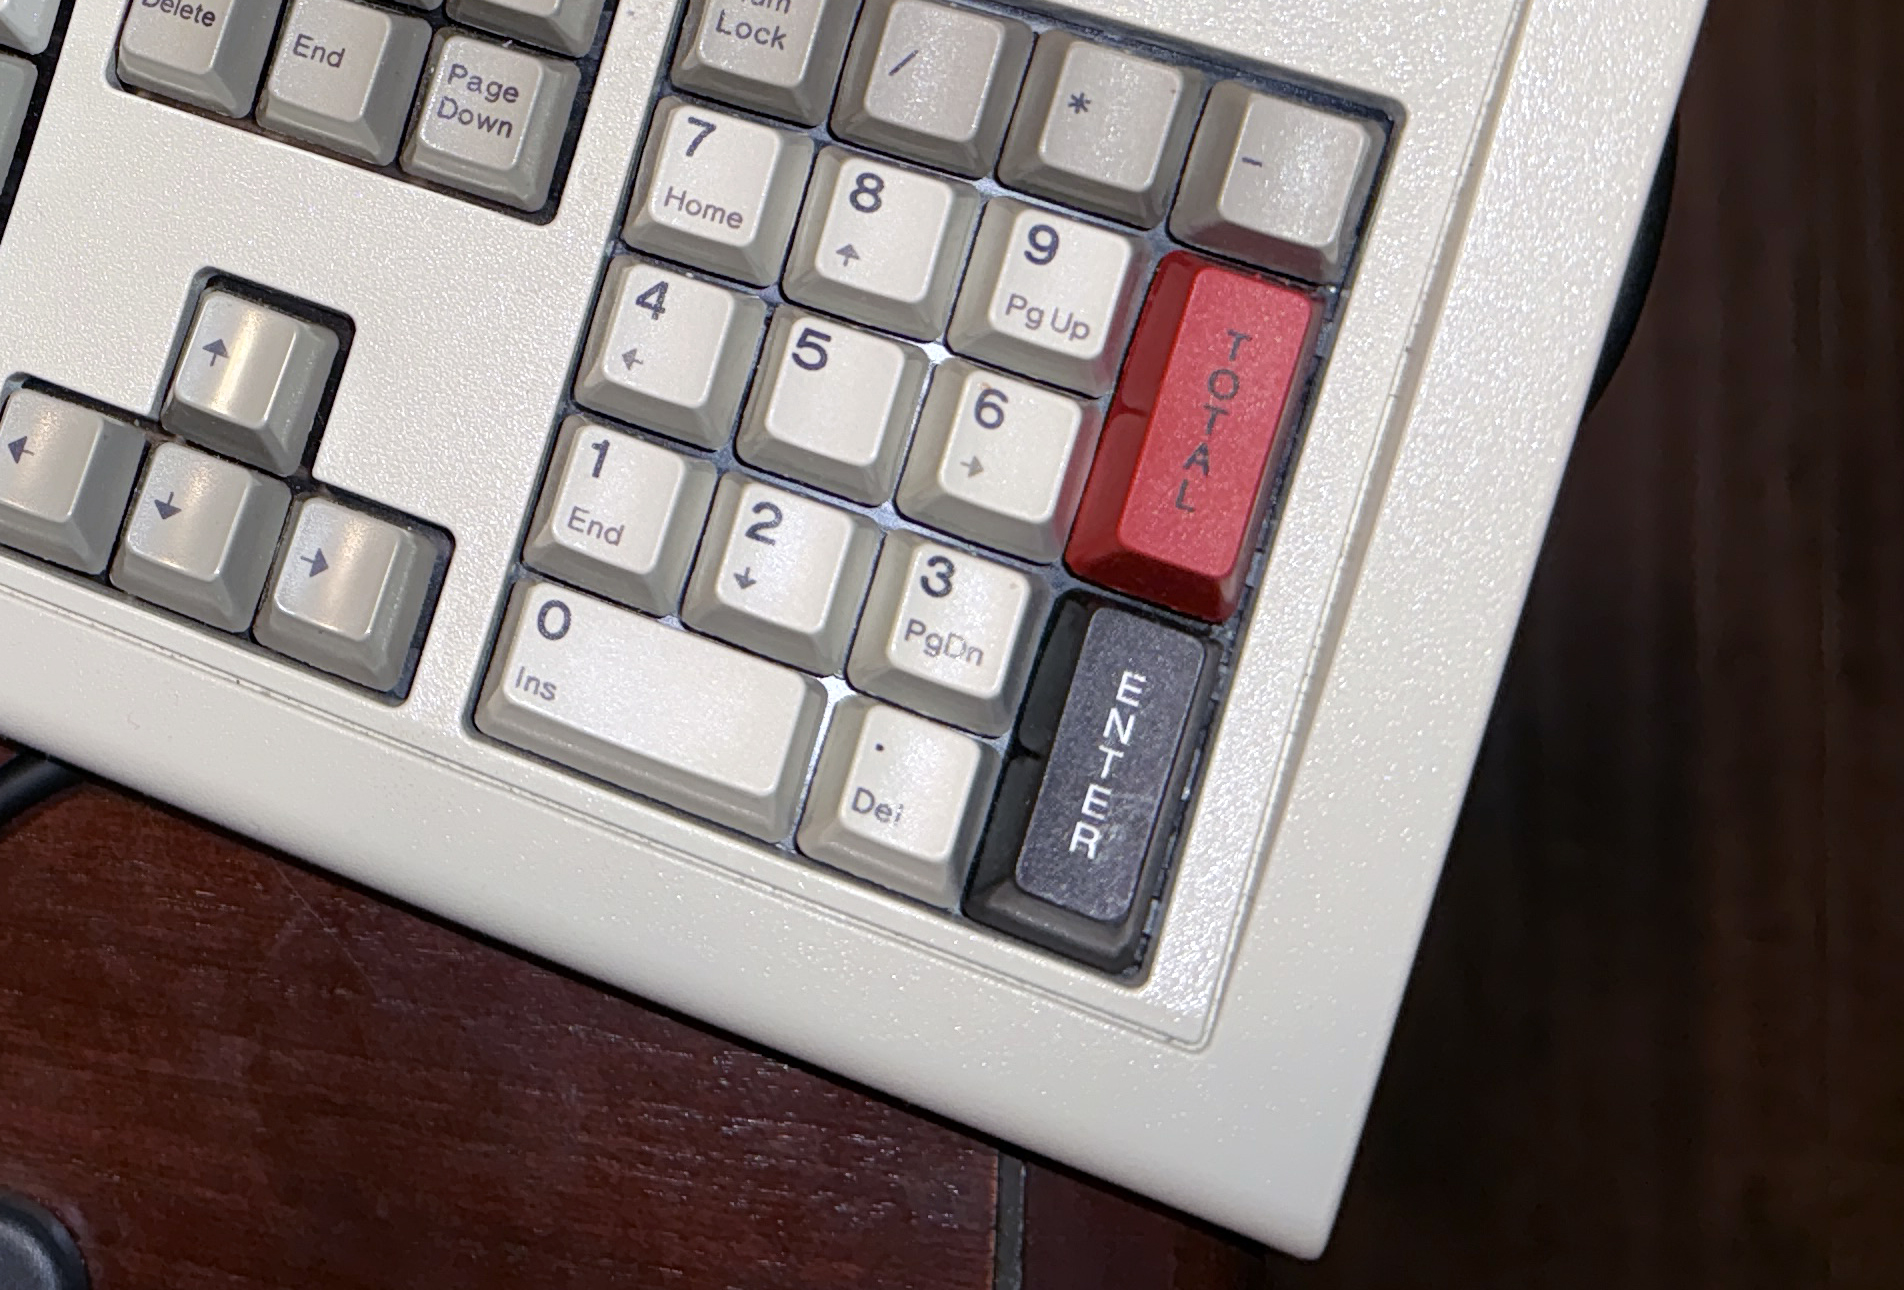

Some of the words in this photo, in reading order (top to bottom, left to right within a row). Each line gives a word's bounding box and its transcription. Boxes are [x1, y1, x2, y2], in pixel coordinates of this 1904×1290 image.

[292, 33, 346, 69] End
[715, 11, 787, 51] Lock
[446, 64, 520, 103] Page
[888, 49, 919, 77] /
[436, 97, 514, 140] Down
[685, 116, 717, 157] 7
[664, 186, 744, 231] Home
[849, 172, 885, 214] 8
[1024, 224, 1060, 266] 9
[635, 280, 669, 321] 4
[1005, 292, 1045, 335] Pg
[1050, 308, 1091, 341] Up
[790, 328, 832, 371] 5
[974, 387, 1009, 430] 6
[1174, 328, 1253, 513] TOTAL
[591, 439, 611, 479] 1
[566, 505, 625, 547] End
[745, 501, 783, 545] 2
[920, 555, 955, 598] 3
[537, 599, 572, 641] 0
[514, 666, 558, 703] Ins
[1069, 670, 1147, 860] ENTER
